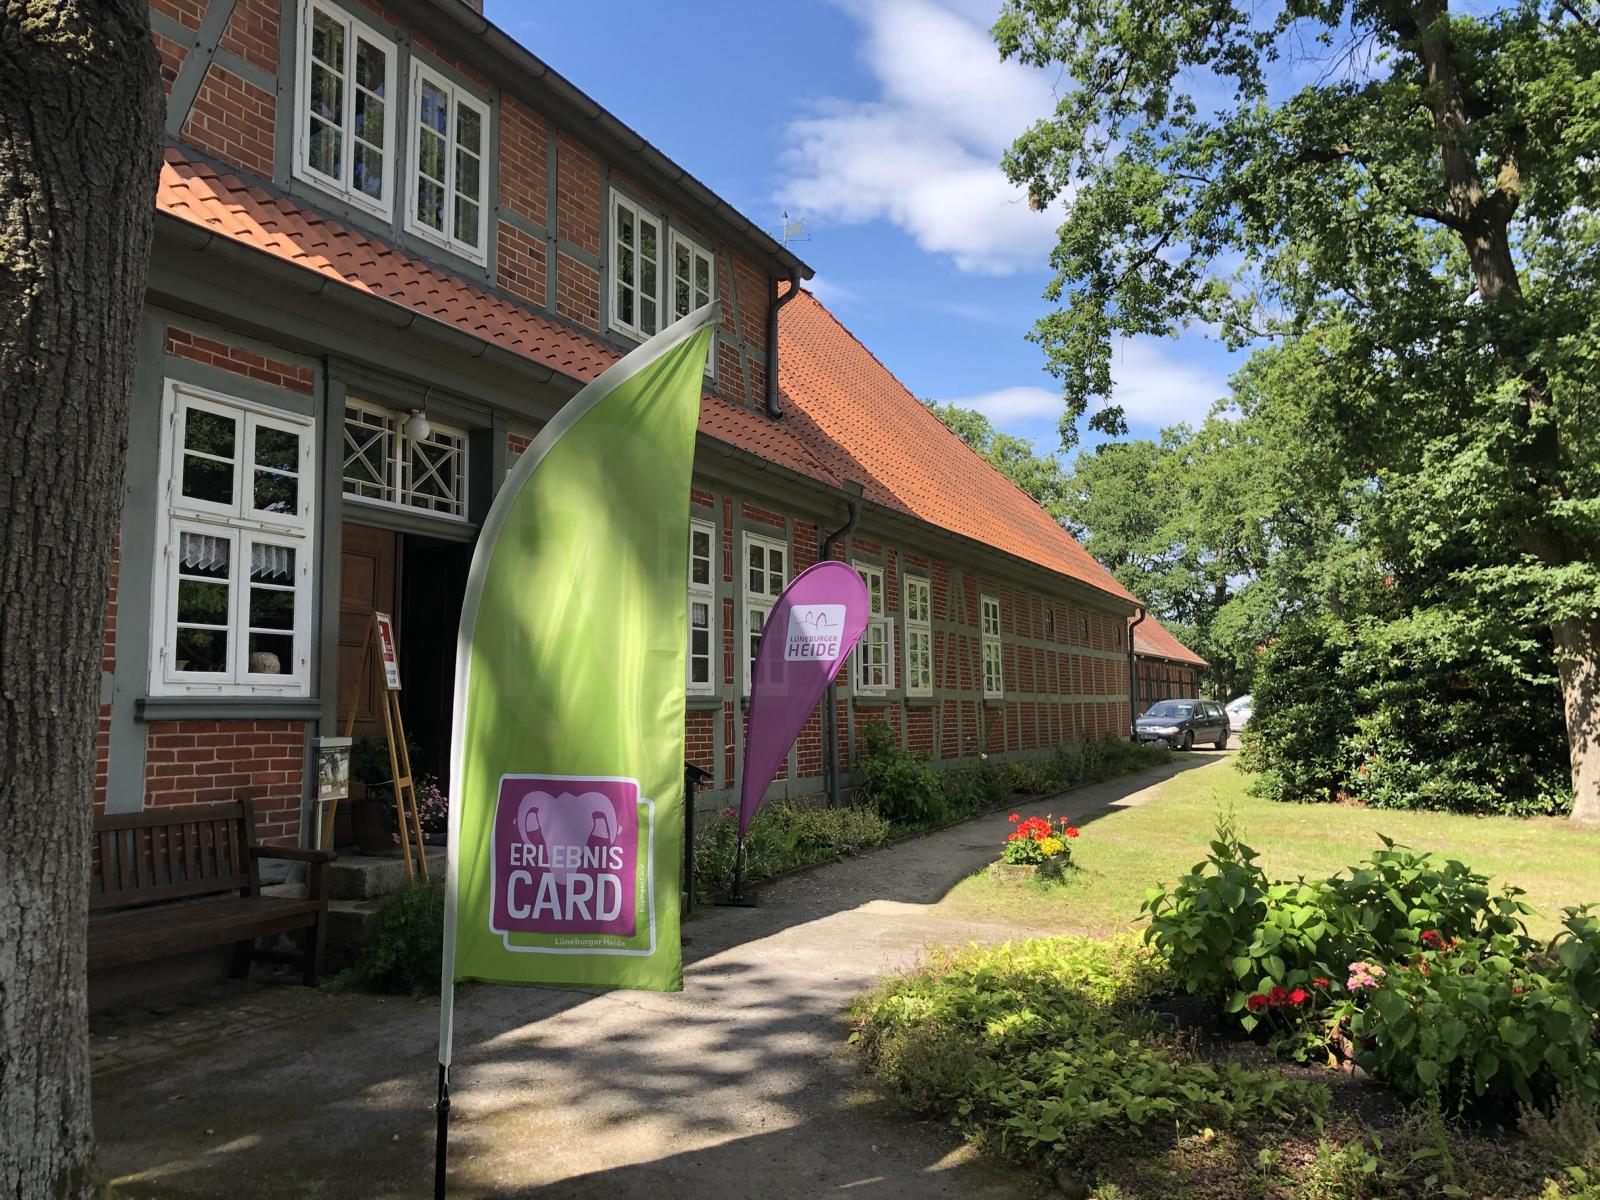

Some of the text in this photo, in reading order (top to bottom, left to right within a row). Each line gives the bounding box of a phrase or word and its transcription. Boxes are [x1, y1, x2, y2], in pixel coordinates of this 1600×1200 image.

[790, 634, 838, 643] LÜNEBURGER
[788, 643, 837, 657] HEIDE
[510, 842, 624, 870] ERLEBNIS
[507, 870, 622, 922] CARD
[555, 937, 626, 947] Lüneburger Heide
